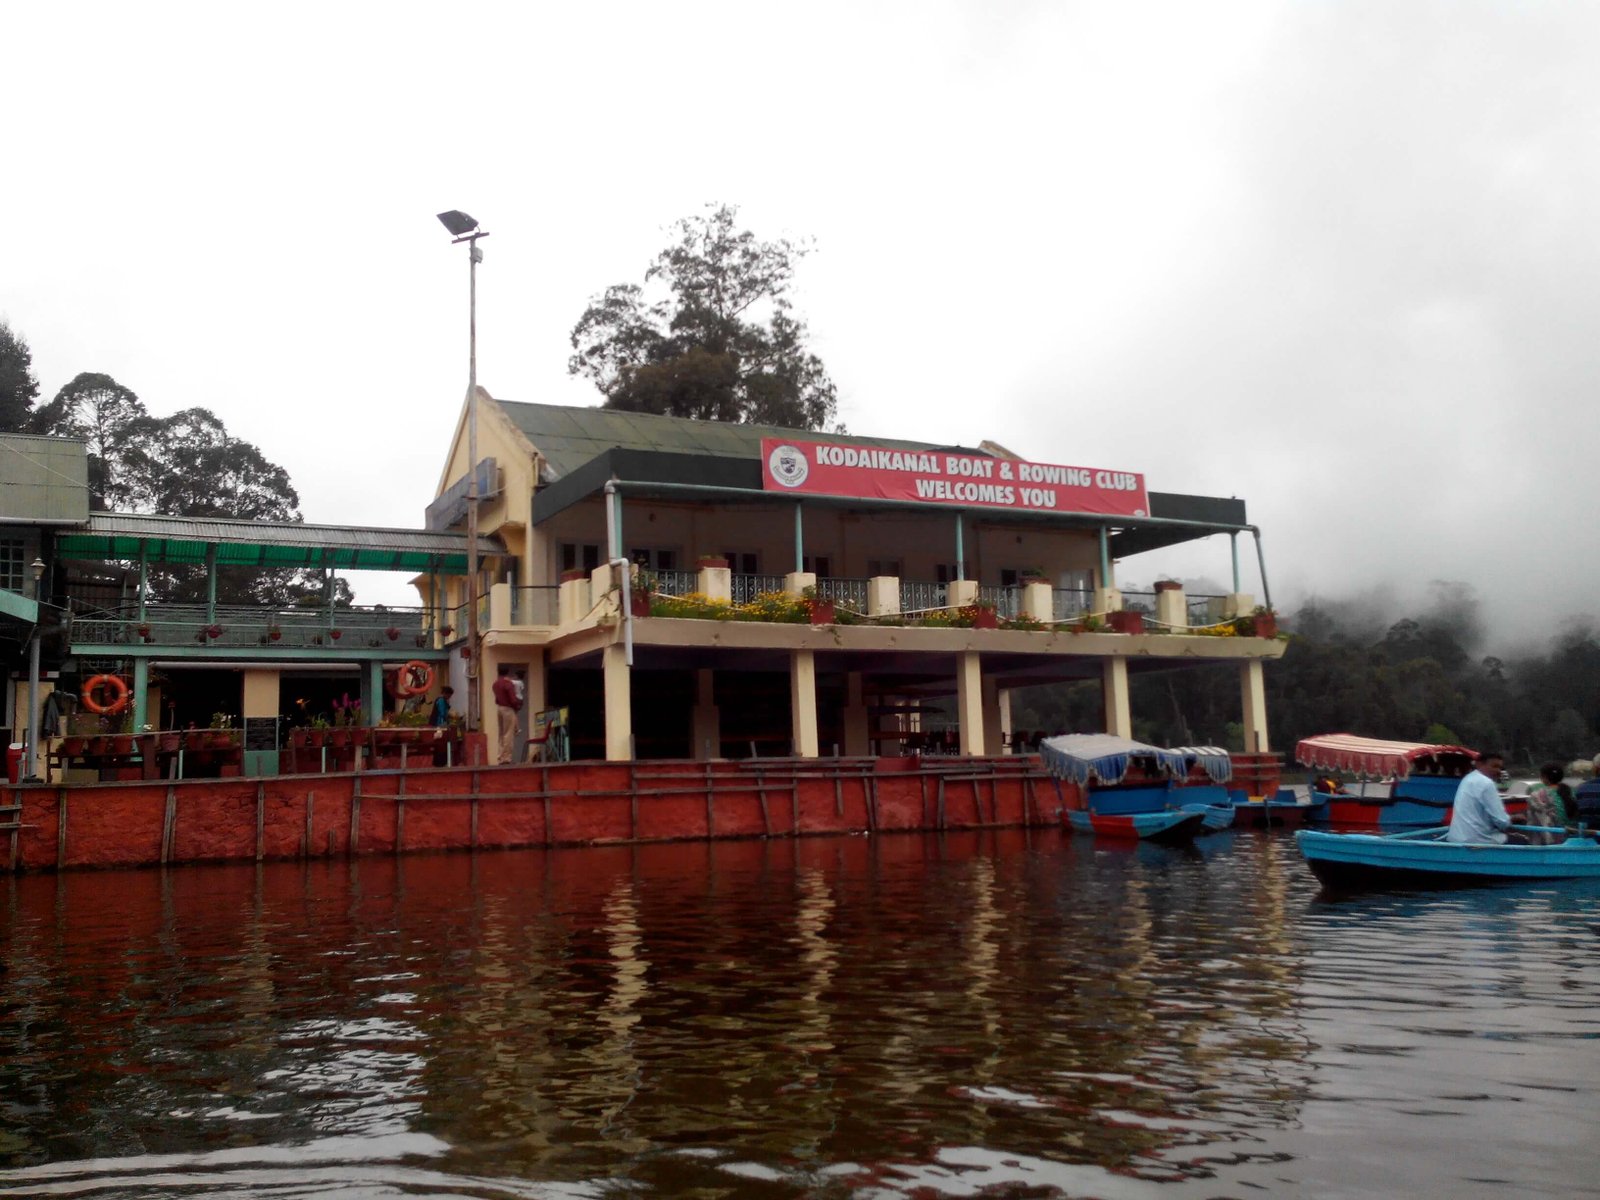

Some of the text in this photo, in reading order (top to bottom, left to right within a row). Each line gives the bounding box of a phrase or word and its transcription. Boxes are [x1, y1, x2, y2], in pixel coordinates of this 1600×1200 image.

[815, 445, 1137, 491] KODAIKANAL BOAT & ROWING CLUB
[915, 479, 1057, 508] WELCOMES YOU
